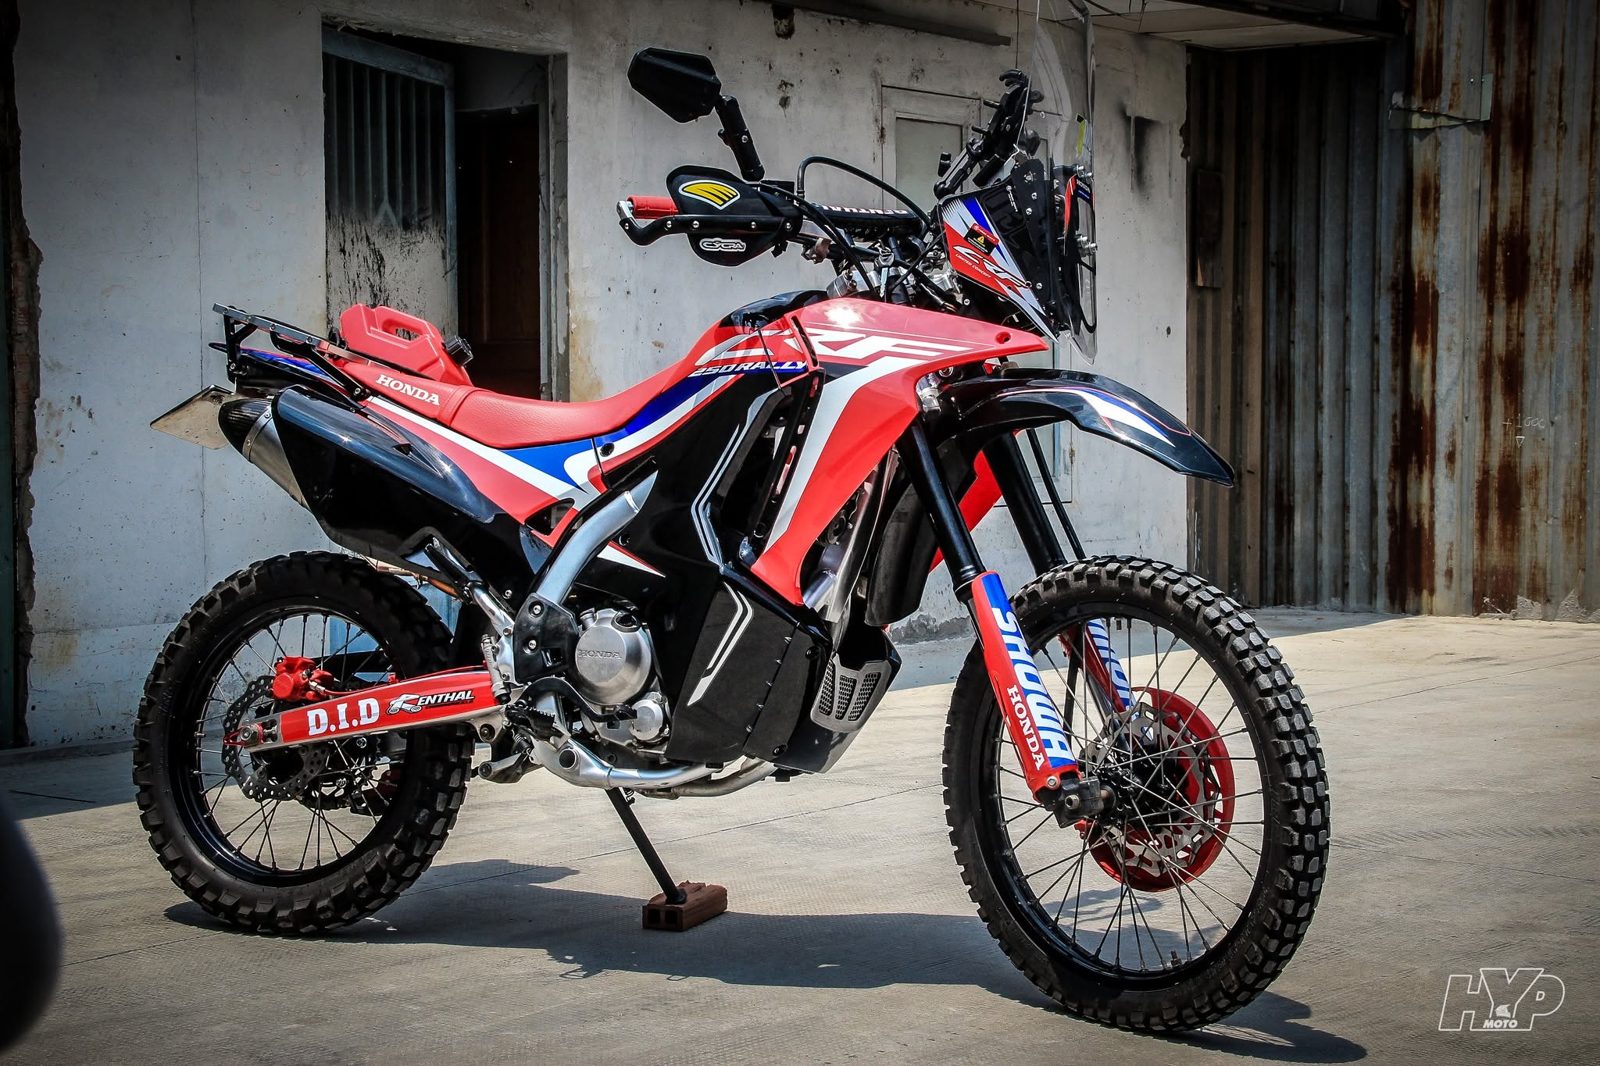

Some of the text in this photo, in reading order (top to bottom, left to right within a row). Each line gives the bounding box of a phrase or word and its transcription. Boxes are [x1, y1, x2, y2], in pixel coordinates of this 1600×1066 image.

[701, 238, 746, 251] CYCRA
[953, 245, 1029, 288] CRF
[376, 374, 440, 406] HONDA
[578, 648, 622, 660] HONDA
[991, 607, 1076, 762] SHOWA
[307, 698, 380, 736] D.I.D
[1006, 684, 1047, 770] HONDA
